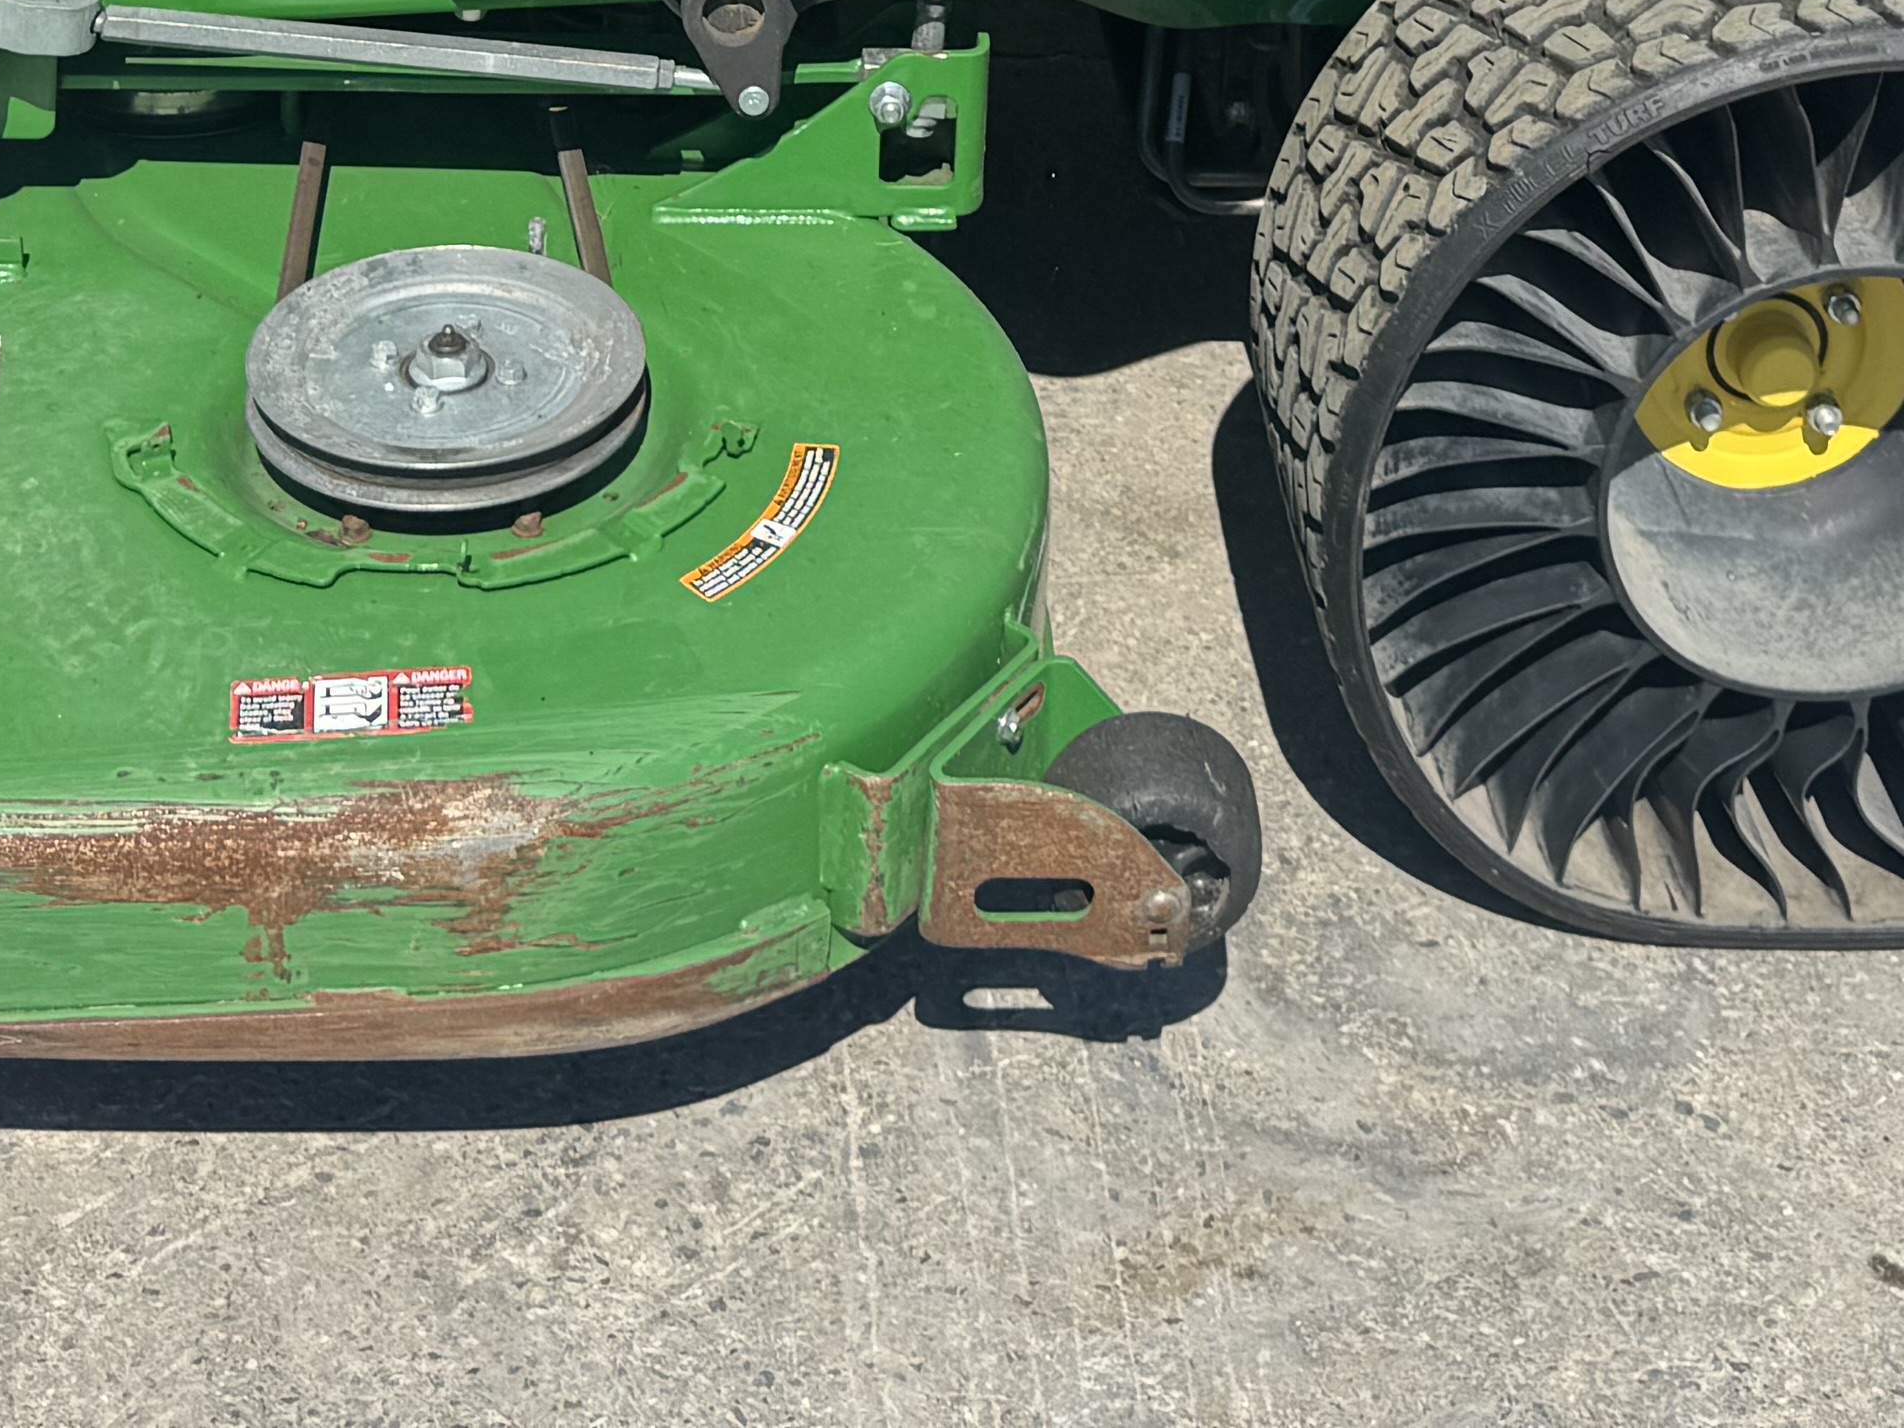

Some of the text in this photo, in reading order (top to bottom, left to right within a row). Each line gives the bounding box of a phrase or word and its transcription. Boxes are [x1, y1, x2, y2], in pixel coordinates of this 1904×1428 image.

[1587, 95, 1665, 146] TURF
[411, 668, 467, 684] DANGER
[252, 679, 302, 695] DANGE
